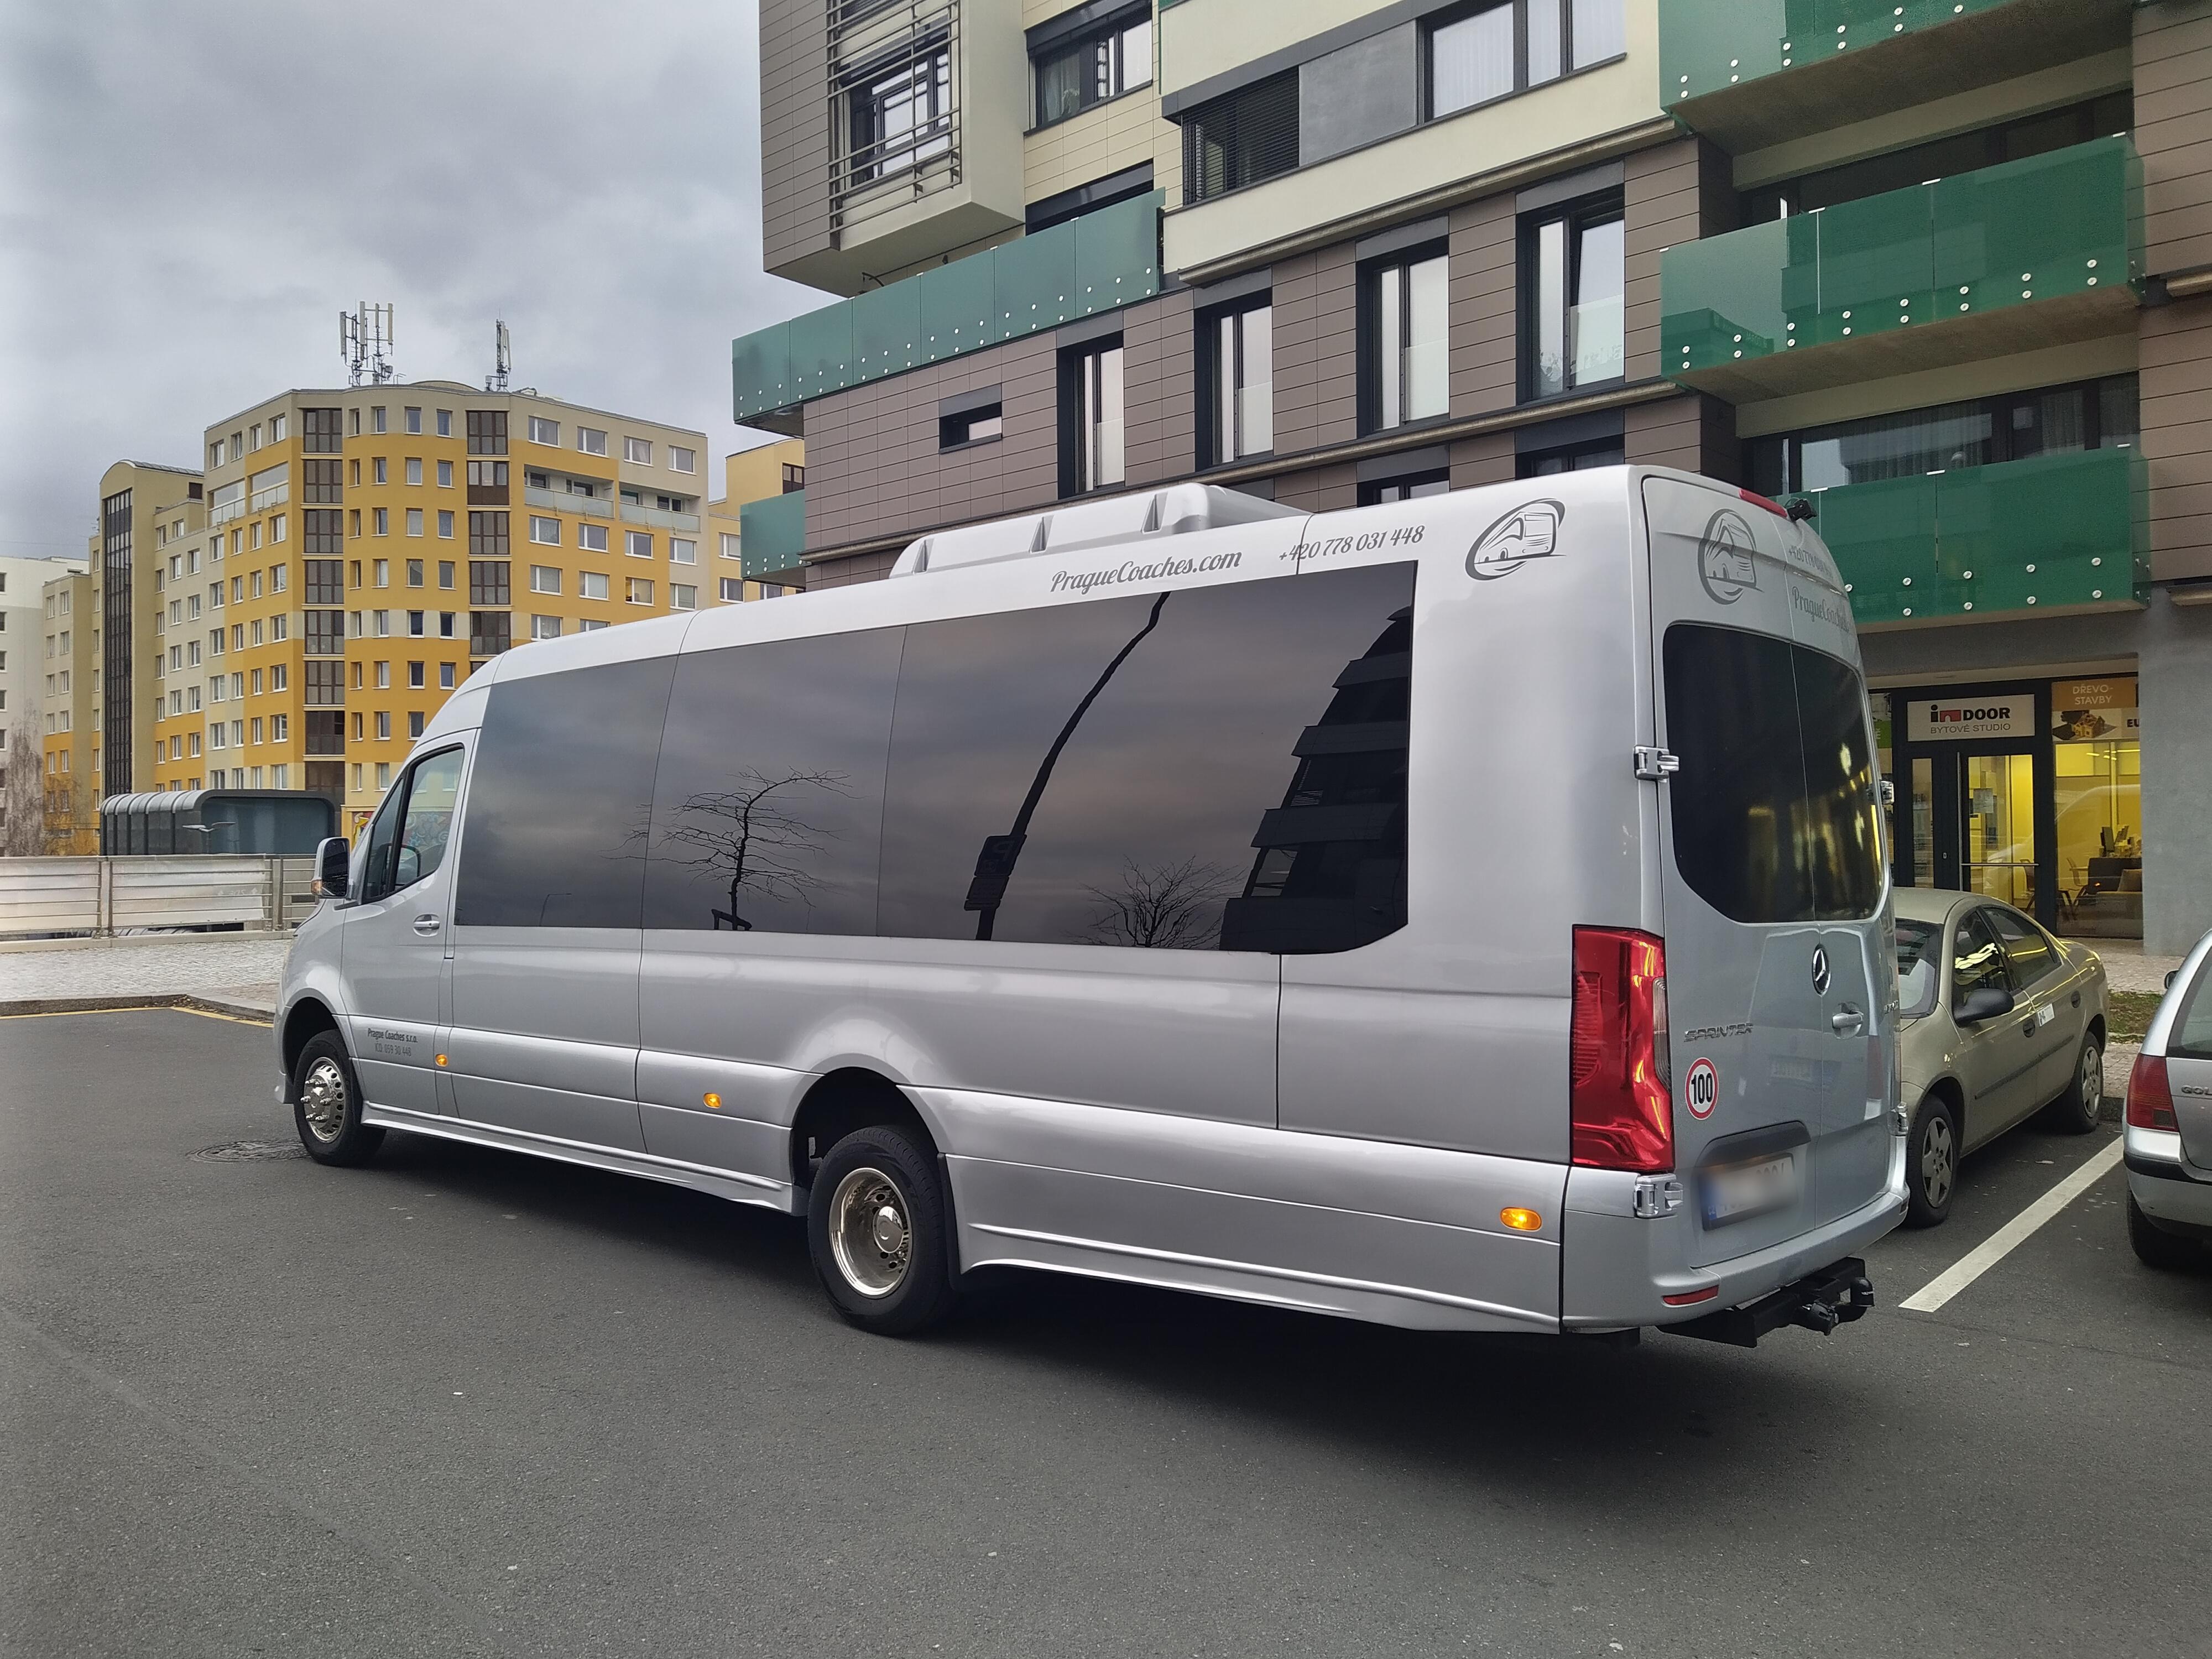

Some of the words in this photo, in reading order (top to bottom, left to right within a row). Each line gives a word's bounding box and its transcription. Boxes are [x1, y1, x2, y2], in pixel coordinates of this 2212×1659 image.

[1279, 541, 1321, 561] +420
[1323, 536, 1354, 556] 778
[1356, 531, 1387, 551] 031
[1390, 525, 1425, 546] 448
[1051, 552, 1242, 594] PragueCoaches.com
[2074, 696, 2112, 705] STAVBY
[1931, 724, 1970, 734] BYTOVÉ
[1973, 723, 2011, 732] STUDIO
[367, 1027, 384, 1040] Prague
[385, 1030, 405, 1042] Coaches
[1683, 1022, 1754, 1042] SPRINTER
[1691, 1073, 1713, 1105] 100
[2181, 1084, 2212, 1095] GOL
